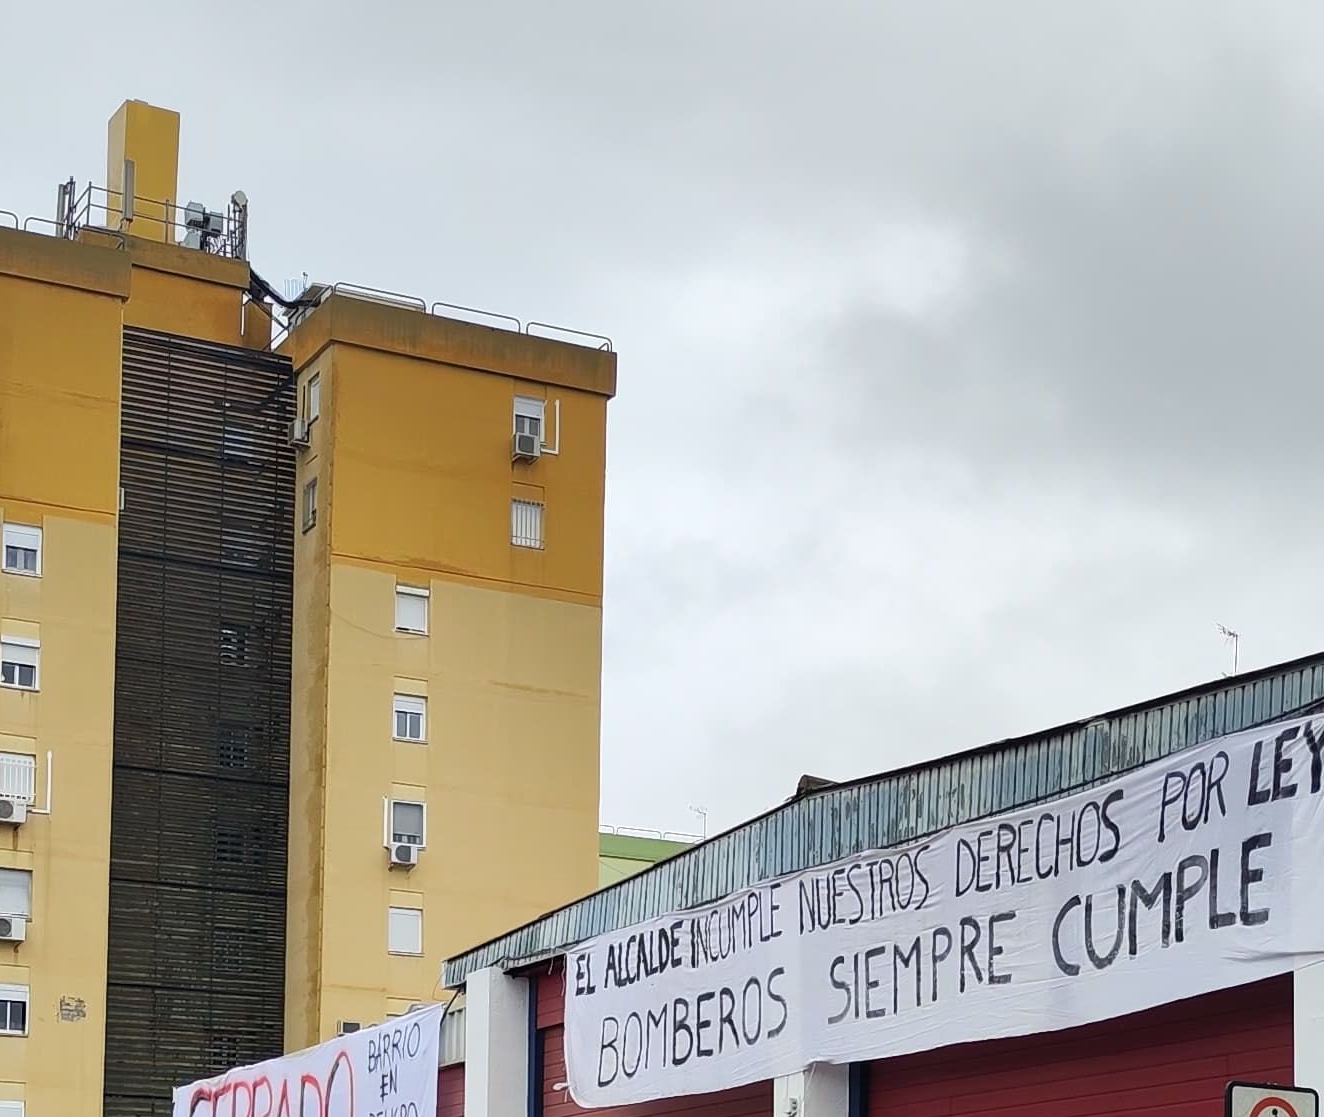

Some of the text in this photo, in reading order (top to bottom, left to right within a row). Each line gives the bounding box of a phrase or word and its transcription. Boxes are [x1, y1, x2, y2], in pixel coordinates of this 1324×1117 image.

[575, 952, 596, 997] EL
[603, 919, 685, 989] ALCALDE
[689, 881, 784, 969] INCUMPLE
[797, 844, 931, 936] NUESTROS
[954, 789, 1125, 898] DERECHOS
[1156, 750, 1230, 844] POR
[597, 832, 1273, 1089] BOMBEROS SIEMPRE CUMPLE
[367, 1021, 421, 1074] BARRIO
[379, 1063, 398, 1103] EN
